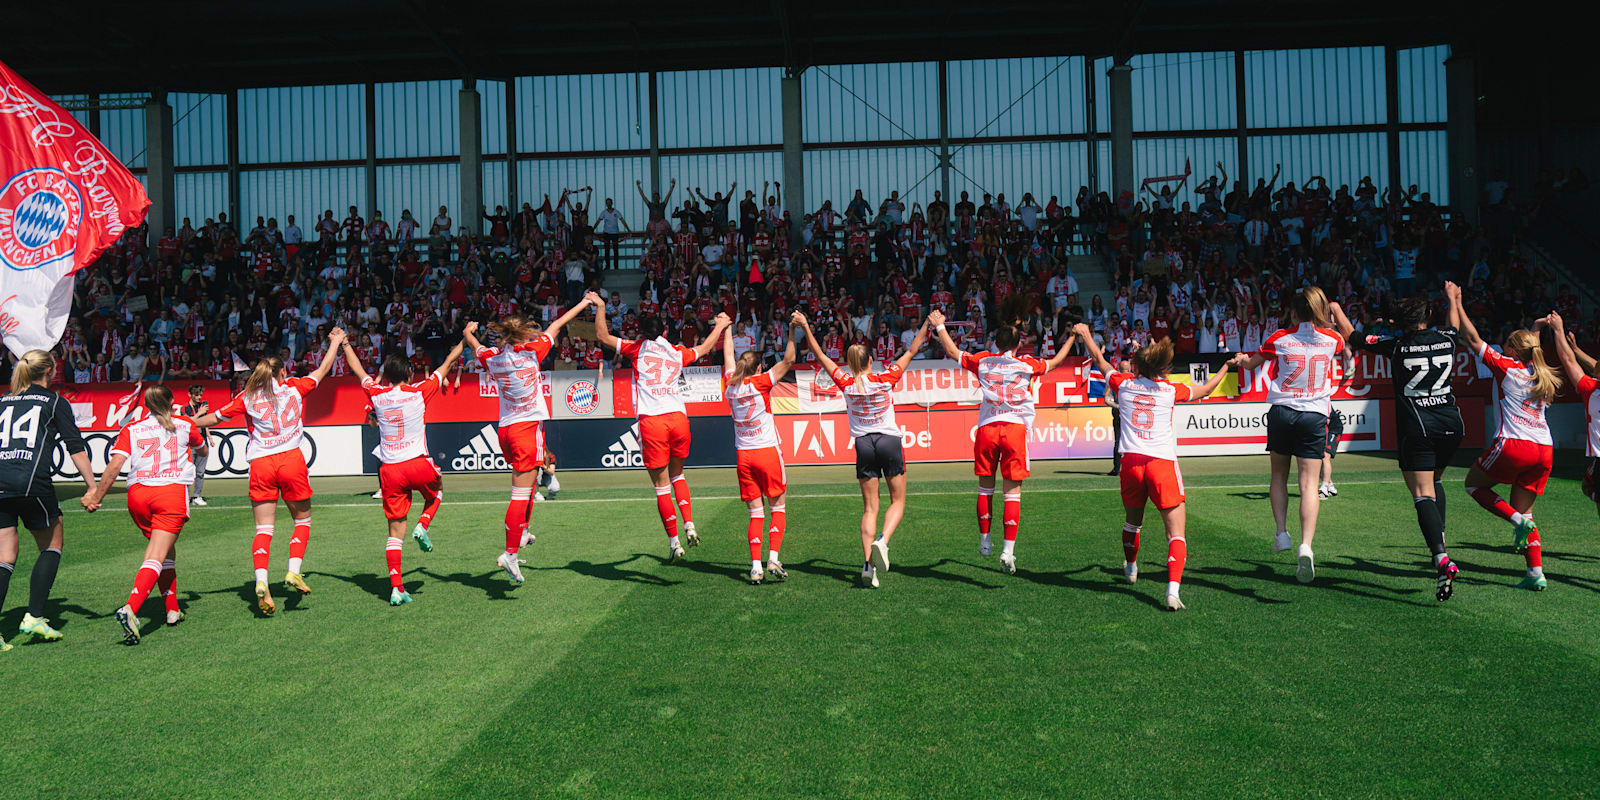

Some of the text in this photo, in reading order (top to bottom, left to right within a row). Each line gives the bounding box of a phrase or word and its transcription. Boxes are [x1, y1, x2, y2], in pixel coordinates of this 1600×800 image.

[14, 175, 39, 196] FC
[643, 355, 681, 387] 37
[1281, 354, 1330, 393] 20
[1403, 353, 1453, 397] 22
[702, 394, 721, 402] ALEX
[1131, 394, 1157, 430] 8
[0, 405, 42, 449] 44
[383, 408, 405, 442] 3
[136, 436, 184, 478] 31
